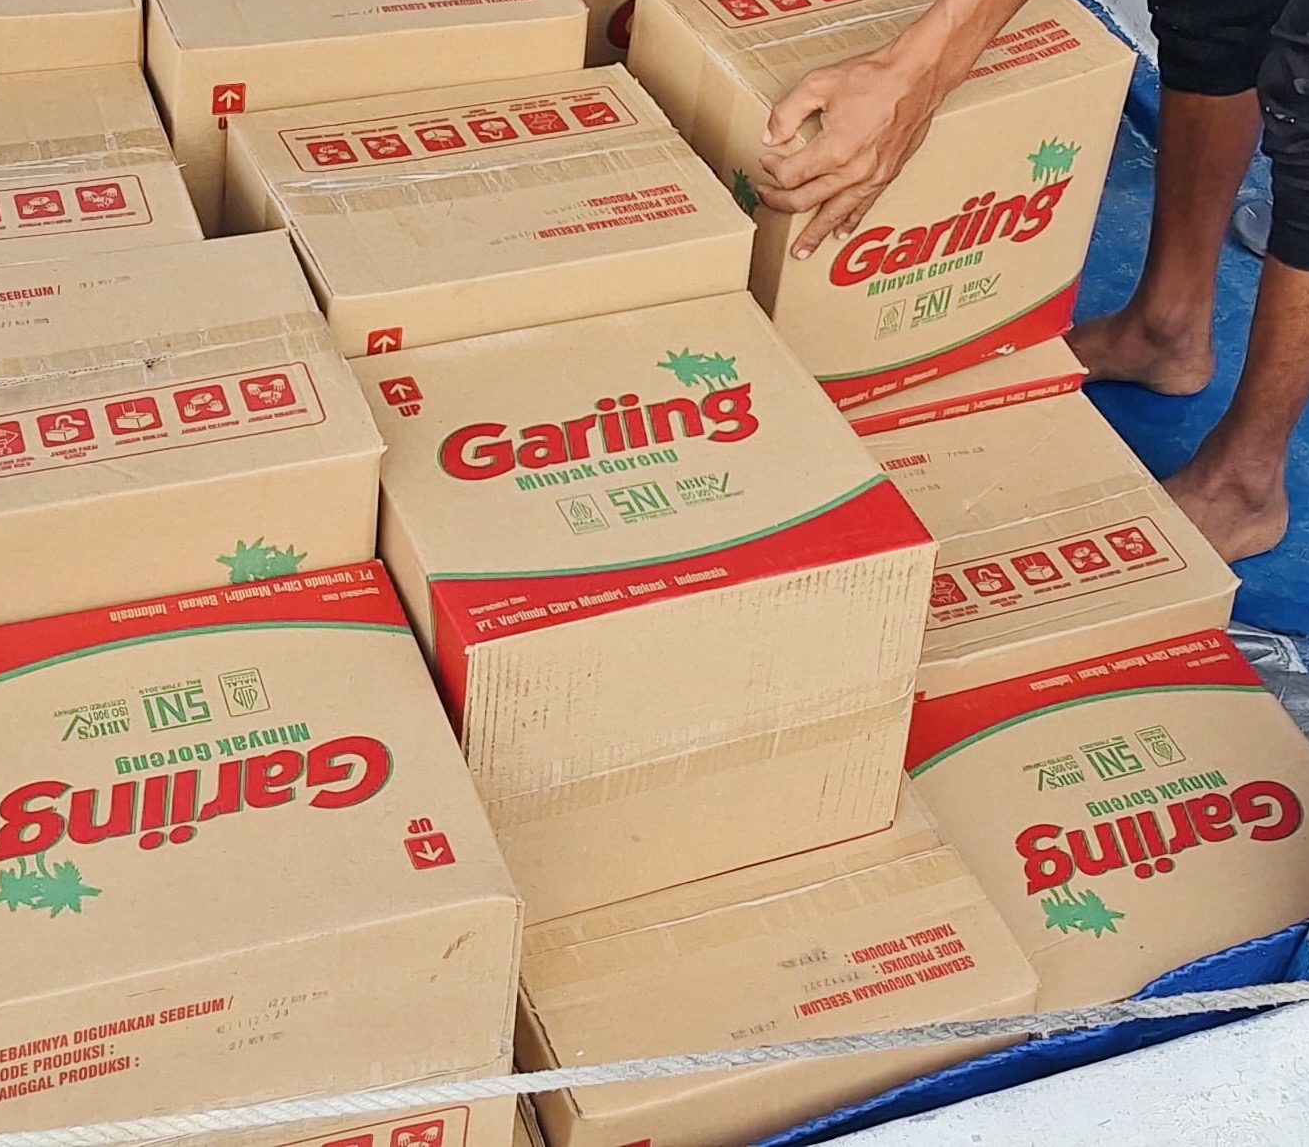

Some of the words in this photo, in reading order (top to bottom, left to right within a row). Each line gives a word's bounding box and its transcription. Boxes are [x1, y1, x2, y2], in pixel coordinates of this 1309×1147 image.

[586, 192, 638, 207] PRODUKSI
[636, 184, 682, 198] TANGGAL
[661, 194, 690, 206] KODE
[610, 199, 662, 215] PRODUKSI
[642, 204, 698, 221] SEBAIKNYA
[537, 223, 586, 239] SEBELUM
[585, 214, 644, 231] DIGUNAKAN
[829, 176, 1073, 286] Gariing
[867, 269, 926, 297] Minyak
[928, 250, 984, 278] Goreng
[912, 286, 953, 322] SNI
[398, 403, 421, 418] UP
[438, 383, 760, 481] Gariing
[515, 464, 598, 491] Minyak
[599, 448, 679, 475] Goreng
[885, 454, 928, 470] SEBELUM
[608, 483, 672, 517] SNI
[273, 579, 303, 592] Citra
[475, 619, 497, 632] PT.
[548, 600, 578, 614] Citra
[674, 567, 728, 586] Indonesia
[109, 603, 167, 622] Indonesia
[111, 706, 129, 717] ISO
[143, 688, 211, 729] SNI
[77, 718, 131, 740] ABICS
[213, 722, 311, 760] Minyak
[115, 741, 212, 775] Goreng
[1085, 744, 1143, 779] SNI
[1152, 771, 1229, 801] Minyak
[1086, 790, 1154, 817] Goreng
[407, 817, 434, 834] UP
[1015, 780, 1304, 895] Gariing
[905, 924, 957, 947] TANGGAL
[851, 938, 908, 963] PRODUKSI
[878, 949, 935, 974] PRODUKSI
[934, 941, 966, 958] KODE
[915, 958, 975, 983] SEBAIKNYA
[851, 974, 916, 1001] DIGUNAKAN
[799, 991, 852, 1016] SEBELUM
[73, 1013, 155, 1045] DIGUNAKAN
[159, 997, 224, 1024] SEBELUM
[33, 1044, 105, 1074] PRODUKSI
[59, 1056, 130, 1086] PRODUKSI
